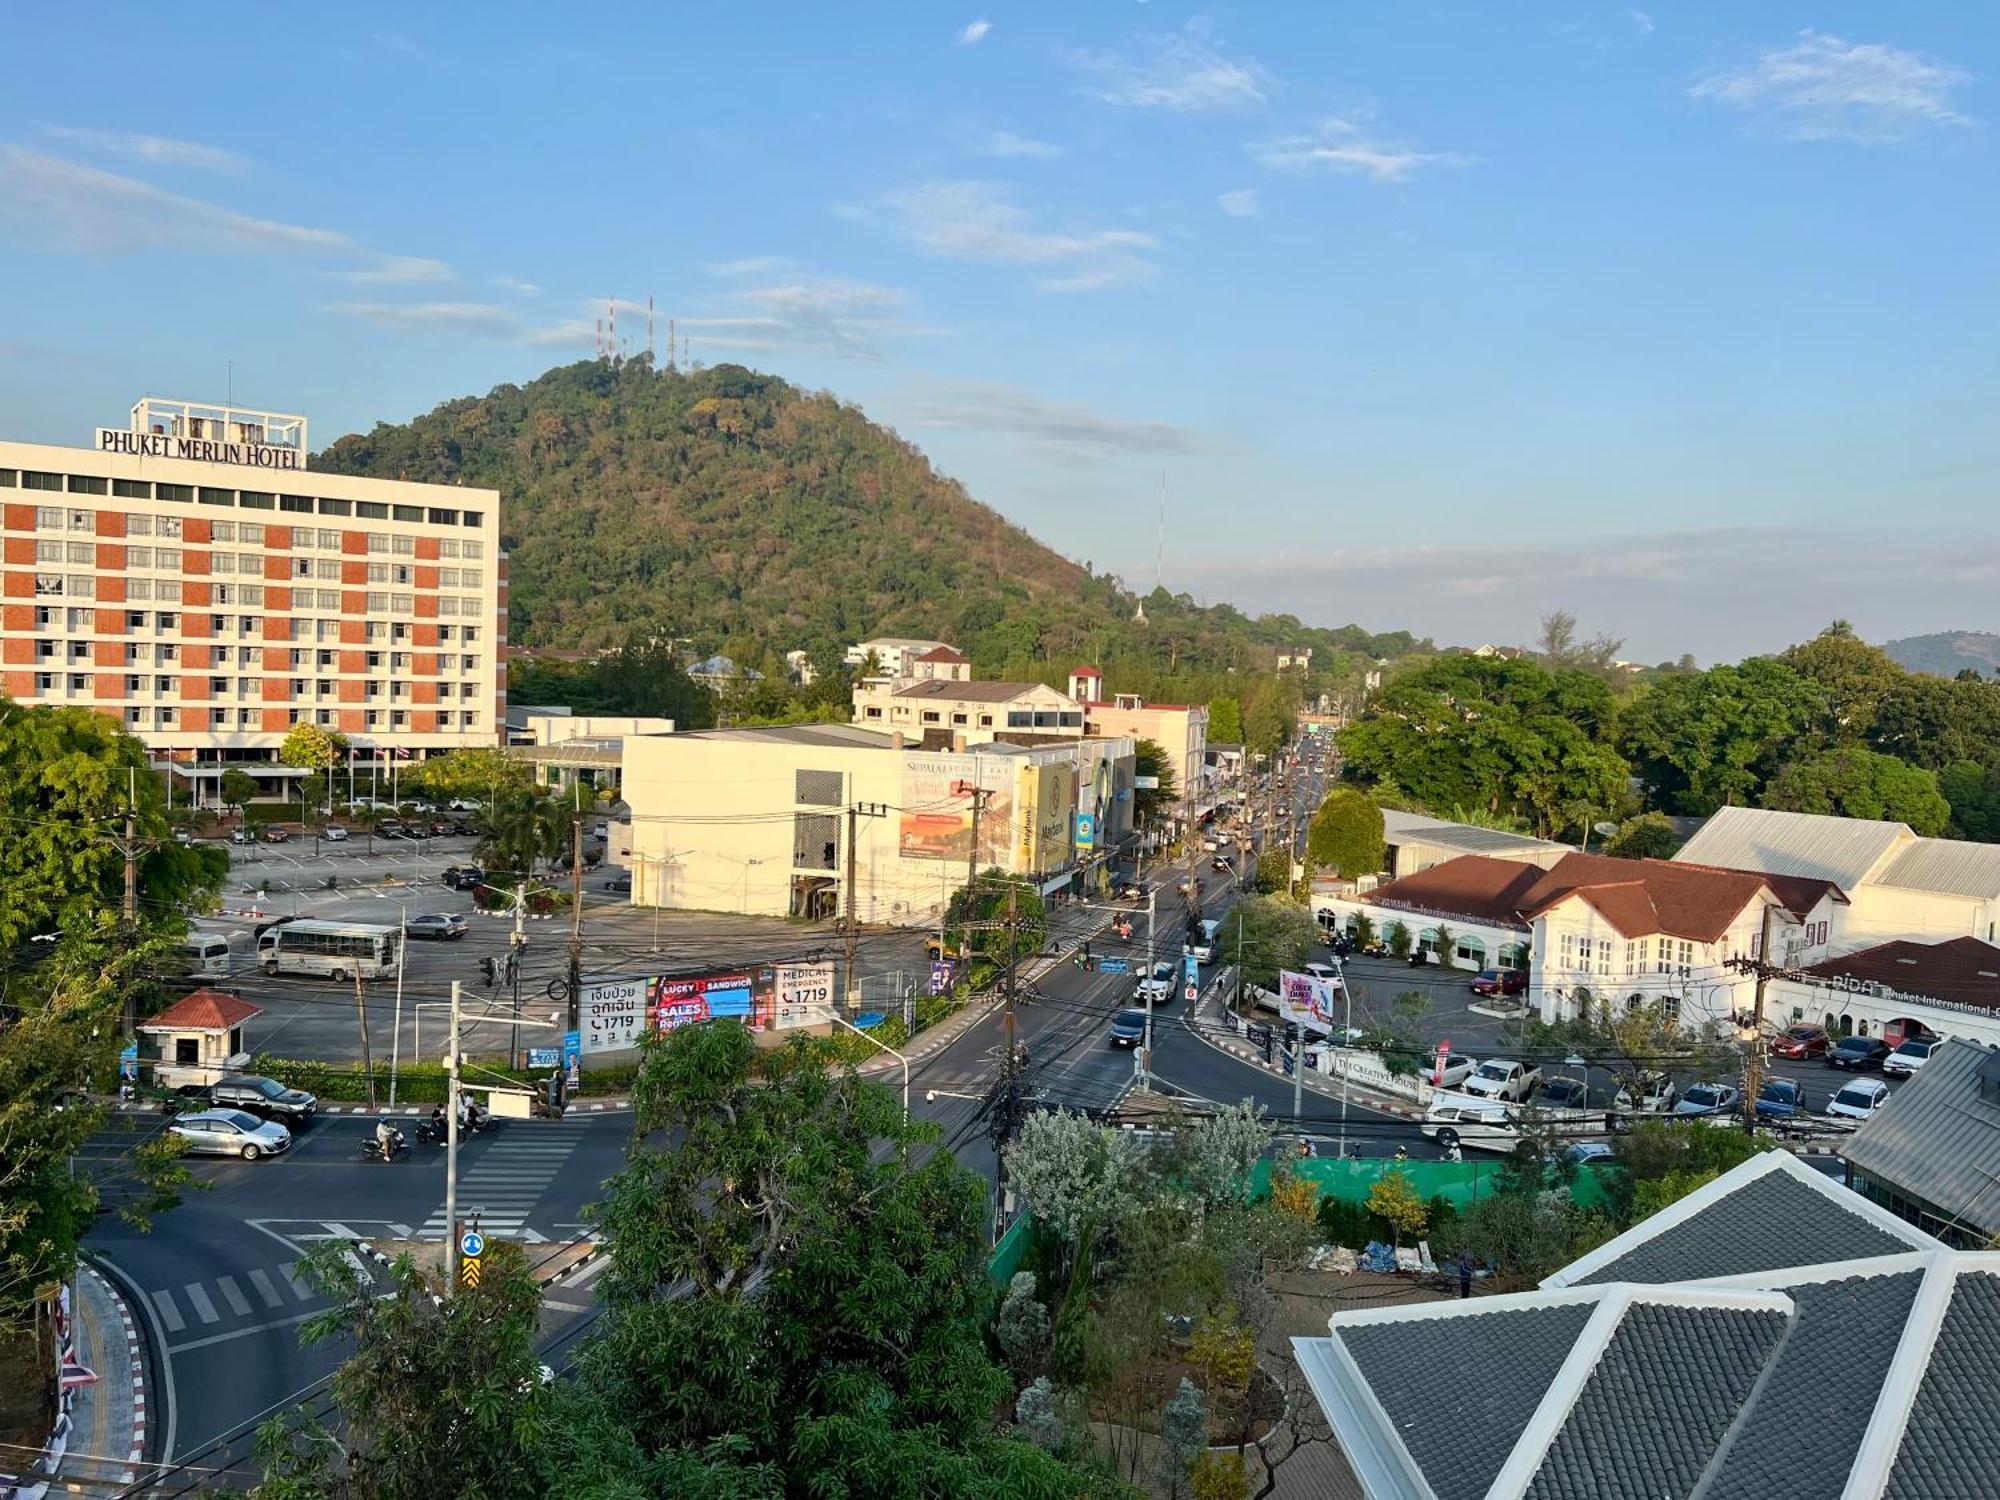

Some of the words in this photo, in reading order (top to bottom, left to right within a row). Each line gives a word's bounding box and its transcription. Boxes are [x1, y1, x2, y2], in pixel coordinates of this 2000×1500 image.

[102, 430, 171, 458] PHUKET
[177, 439, 240, 464] MERLIN
[246, 446, 299, 469] HOTEL
[1023, 807, 1032, 846] Maybank
[783, 969, 829, 980] MEDICAL
[663, 984, 694, 994] LUCKY
[707, 977, 752, 991] SANDWICH
[782, 979, 828, 988] EMERGENCY
[796, 988, 827, 1003] 1719
[1886, 986, 1919, 1003] Phuket
[1922, 994, 1990, 1017] International
[591, 999, 634, 1018] ฉุกเฉิน
[659, 1003, 701, 1017] SALES
[604, 1015, 634, 1029] 1719
